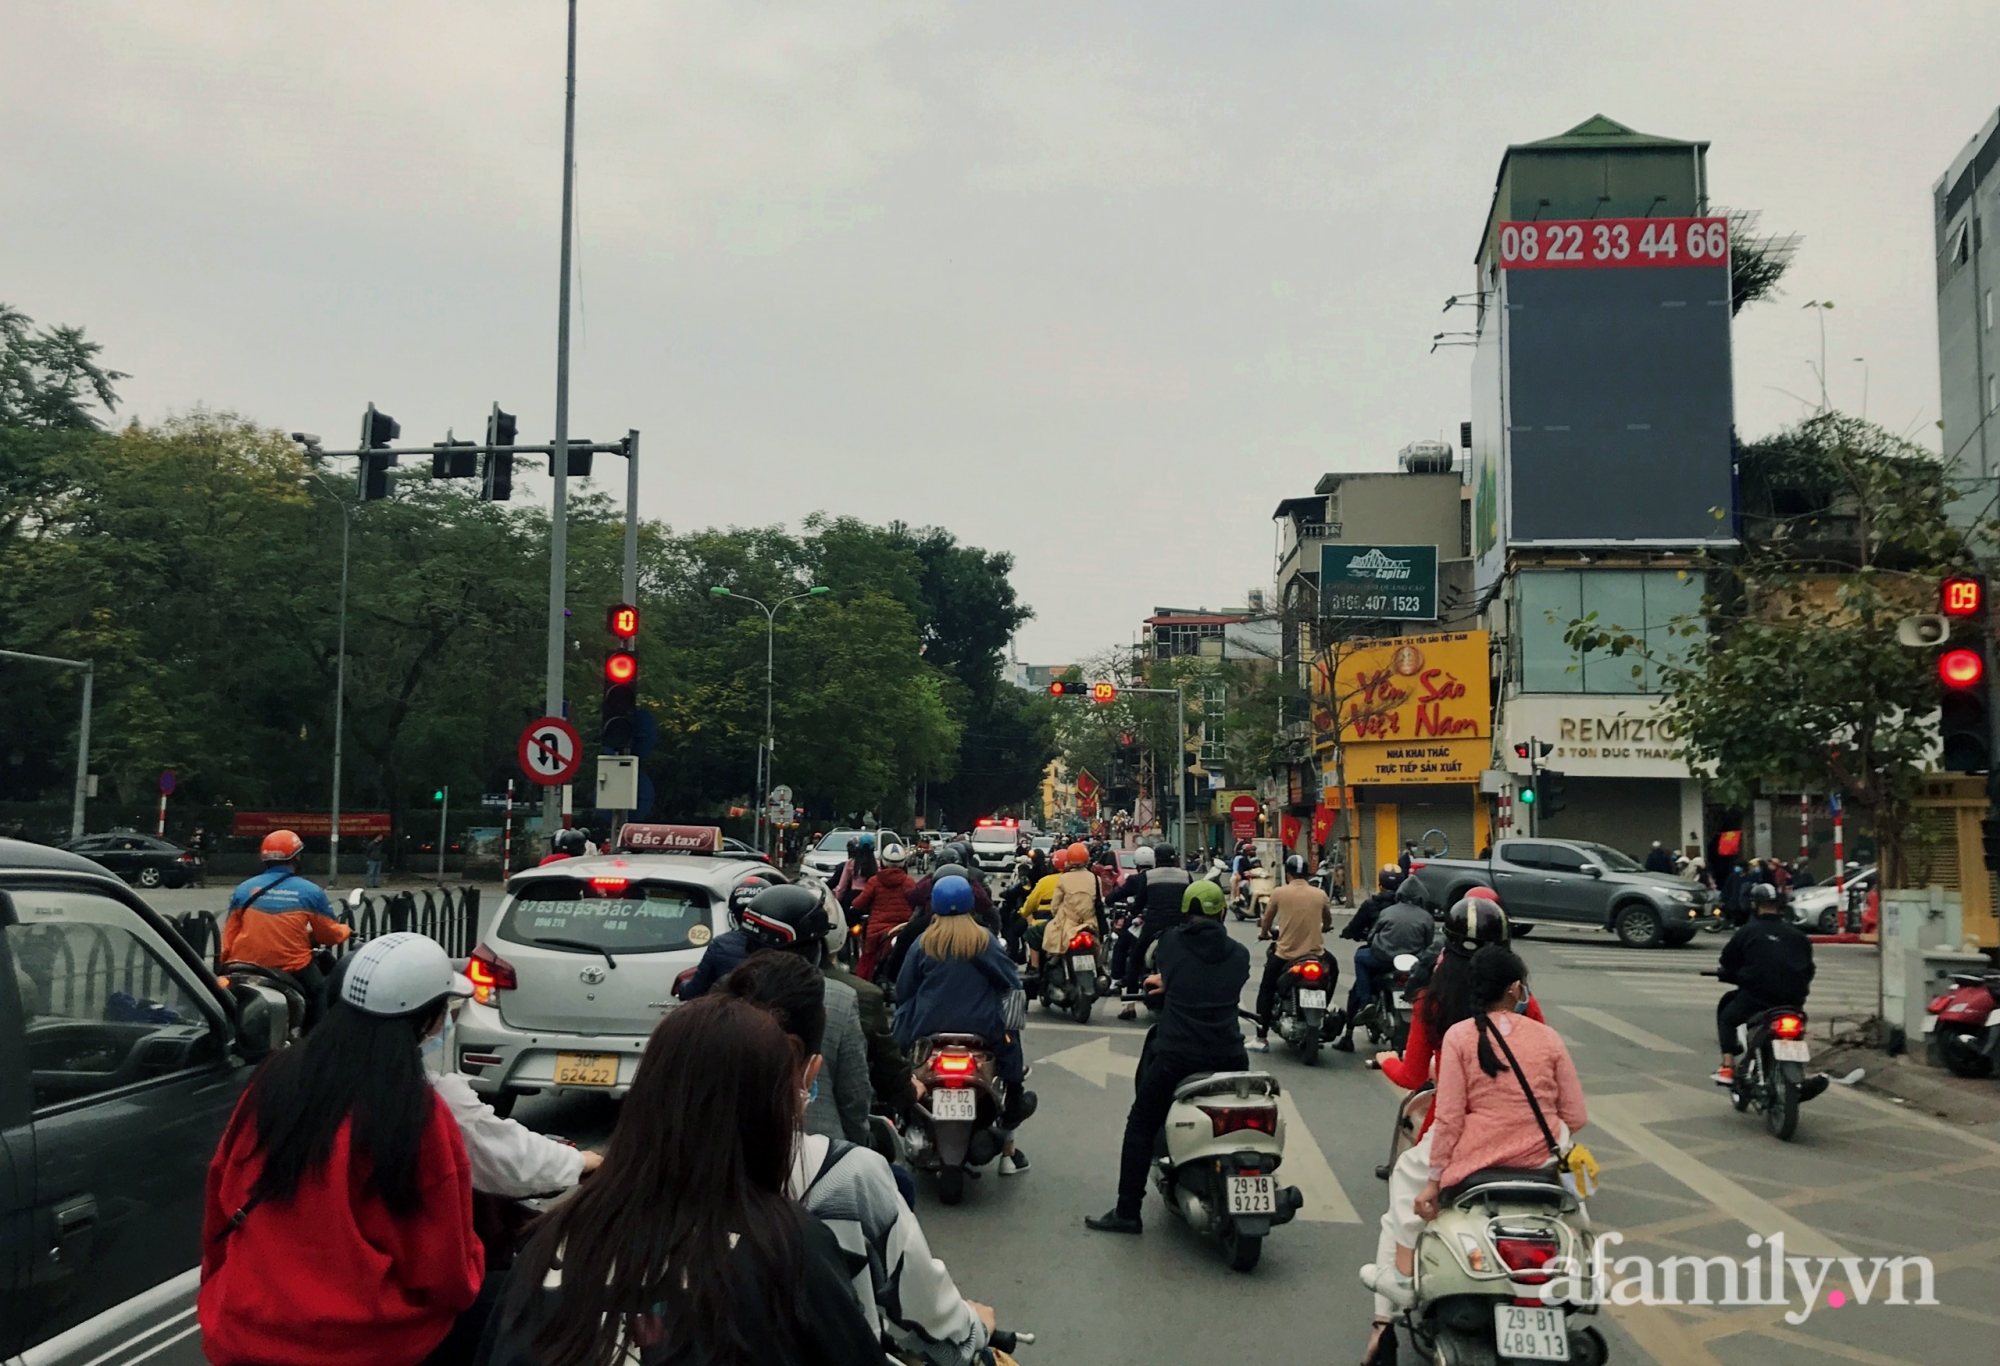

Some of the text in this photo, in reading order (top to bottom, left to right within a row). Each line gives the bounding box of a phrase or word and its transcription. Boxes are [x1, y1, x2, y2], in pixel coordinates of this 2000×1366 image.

[1501, 223, 1726, 261] 08 22 33 44 66
[1375, 569, 1411, 580] Capital
[1951, 583, 1976, 608] 09
[618, 610, 634, 631] 10
[1096, 685, 1112, 698] 09
[1418, 668, 1466, 703] Sào
[1415, 702, 1479, 737] Nam
[1405, 748, 1425, 758] KHAI
[1427, 745, 1450, 757] THÁC
[1399, 760, 1418, 773] TIẾP
[1420, 760, 1438, 772] SẢN
[1440, 759, 1463, 772] XUẤT
[632, 832, 660, 845] Bắc
[691, 930, 708, 940] 622
[560, 1068, 610, 1083] 624.22
[937, 1105, 973, 1117] 415.90
[1234, 1179, 1268, 1194] 29-X8
[1235, 1196, 1270, 1211] 9223
[1506, 1308, 1555, 1332] 29-B1
[1503, 1332, 1563, 1356] 489.13
